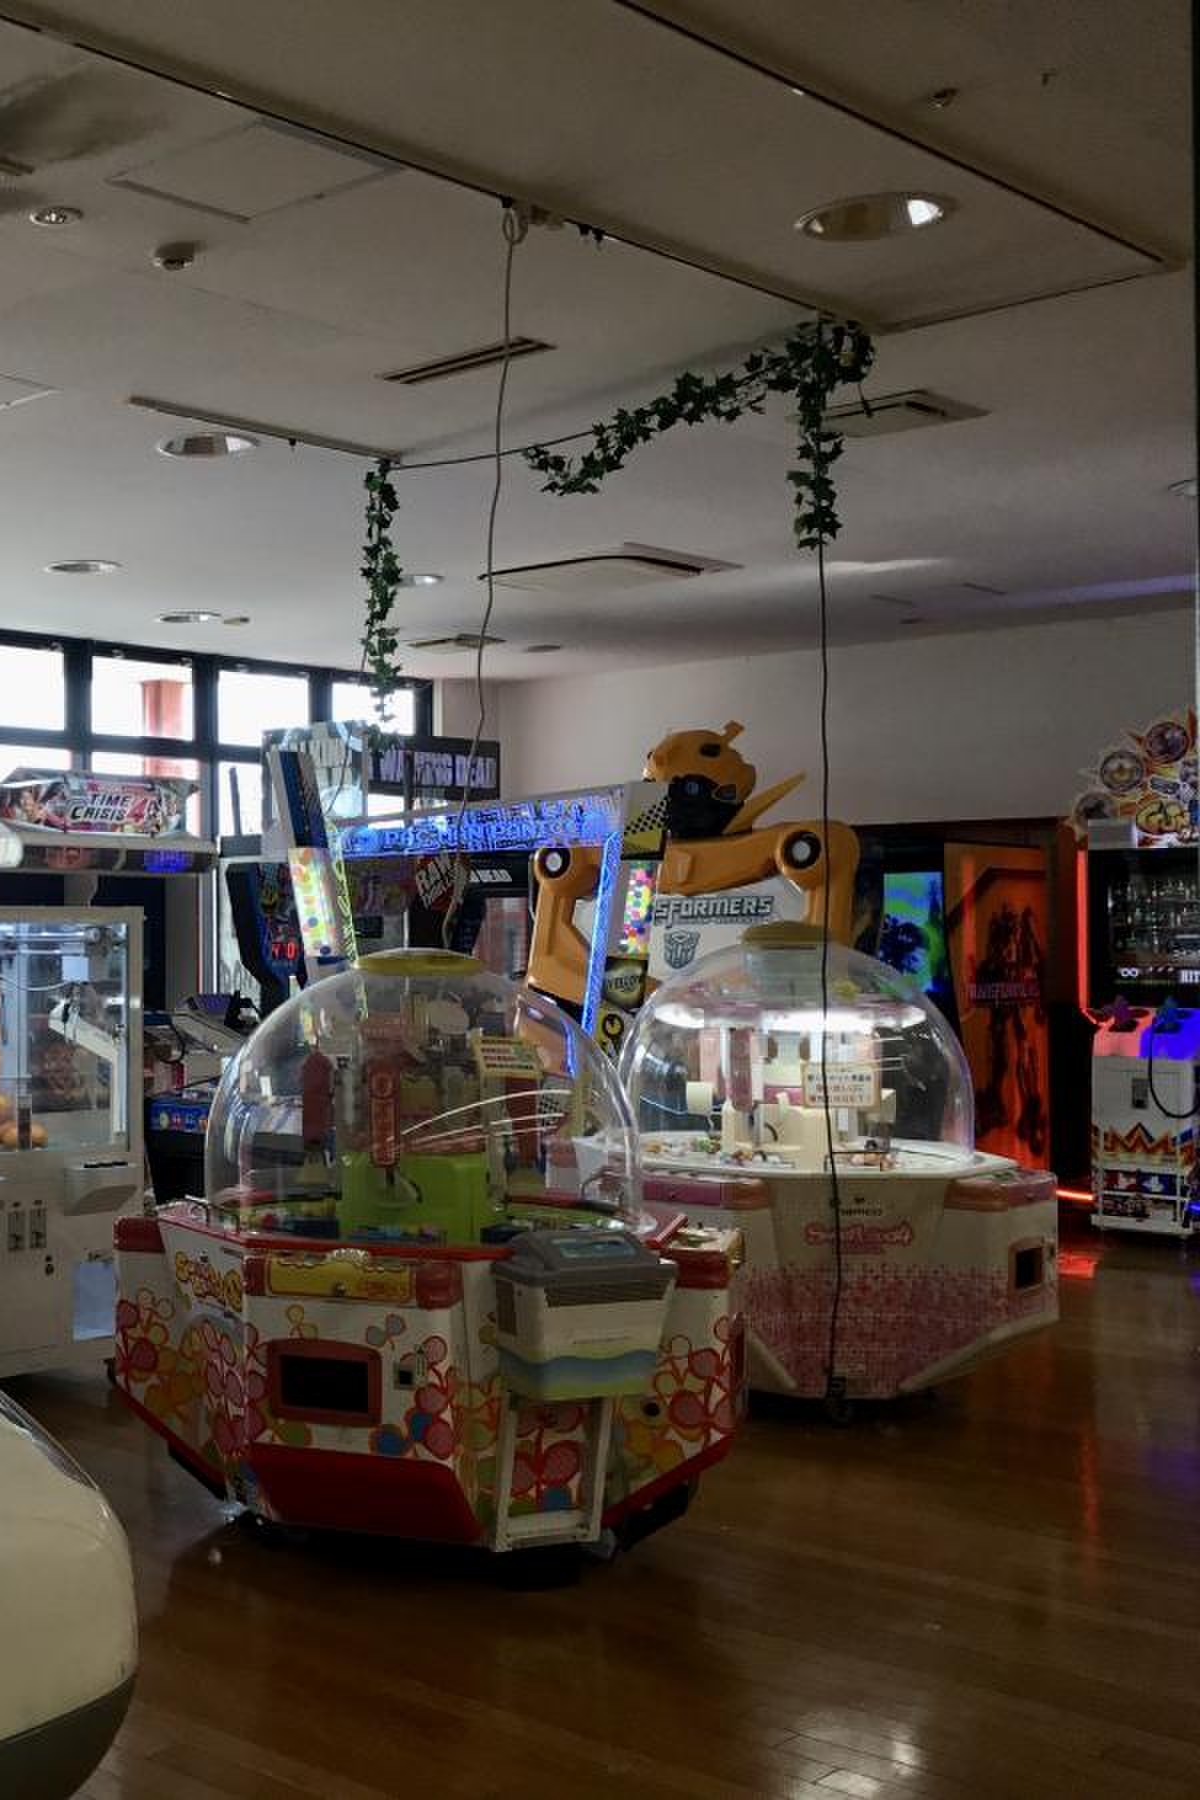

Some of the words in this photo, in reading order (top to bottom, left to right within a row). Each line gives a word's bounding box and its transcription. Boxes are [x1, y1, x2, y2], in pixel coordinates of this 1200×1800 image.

[87, 792, 130, 807] TIME
[69, 805, 126, 823] CRISIS
[126, 798, 147, 824] 4
